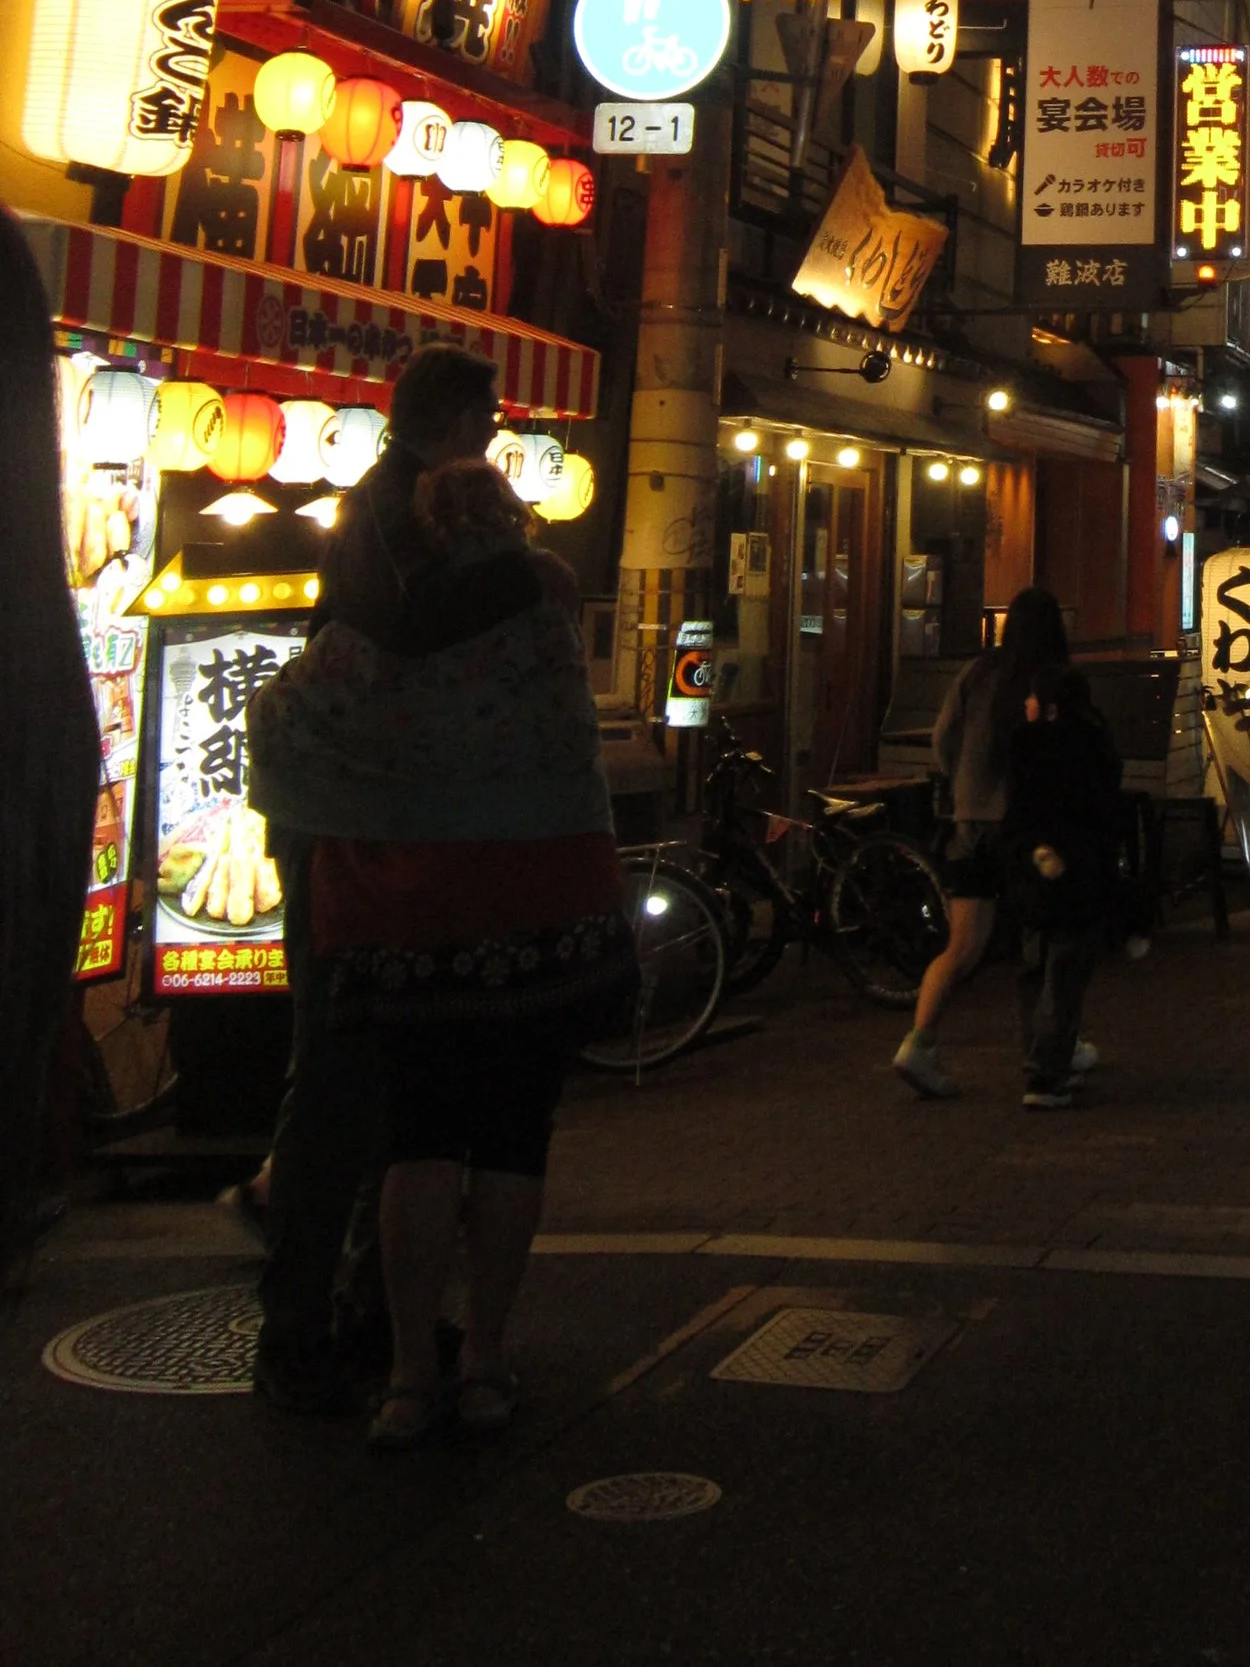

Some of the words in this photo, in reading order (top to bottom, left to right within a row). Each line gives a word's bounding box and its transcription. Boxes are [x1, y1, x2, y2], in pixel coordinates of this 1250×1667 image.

[1039, 65, 1140, 88] 大人数での
[1036, 96, 1147, 133] 宴会場
[1095, 137, 1148, 159] 貸切可
[1181, 63, 1242, 250] 営業中
[1056, 177, 1146, 195] カラオケ付き
[1058, 201, 1146, 218] 鶏鍋あります
[1045, 259, 1128, 286] 難波店
[172, 971, 261, 987] 06-6214-2223
